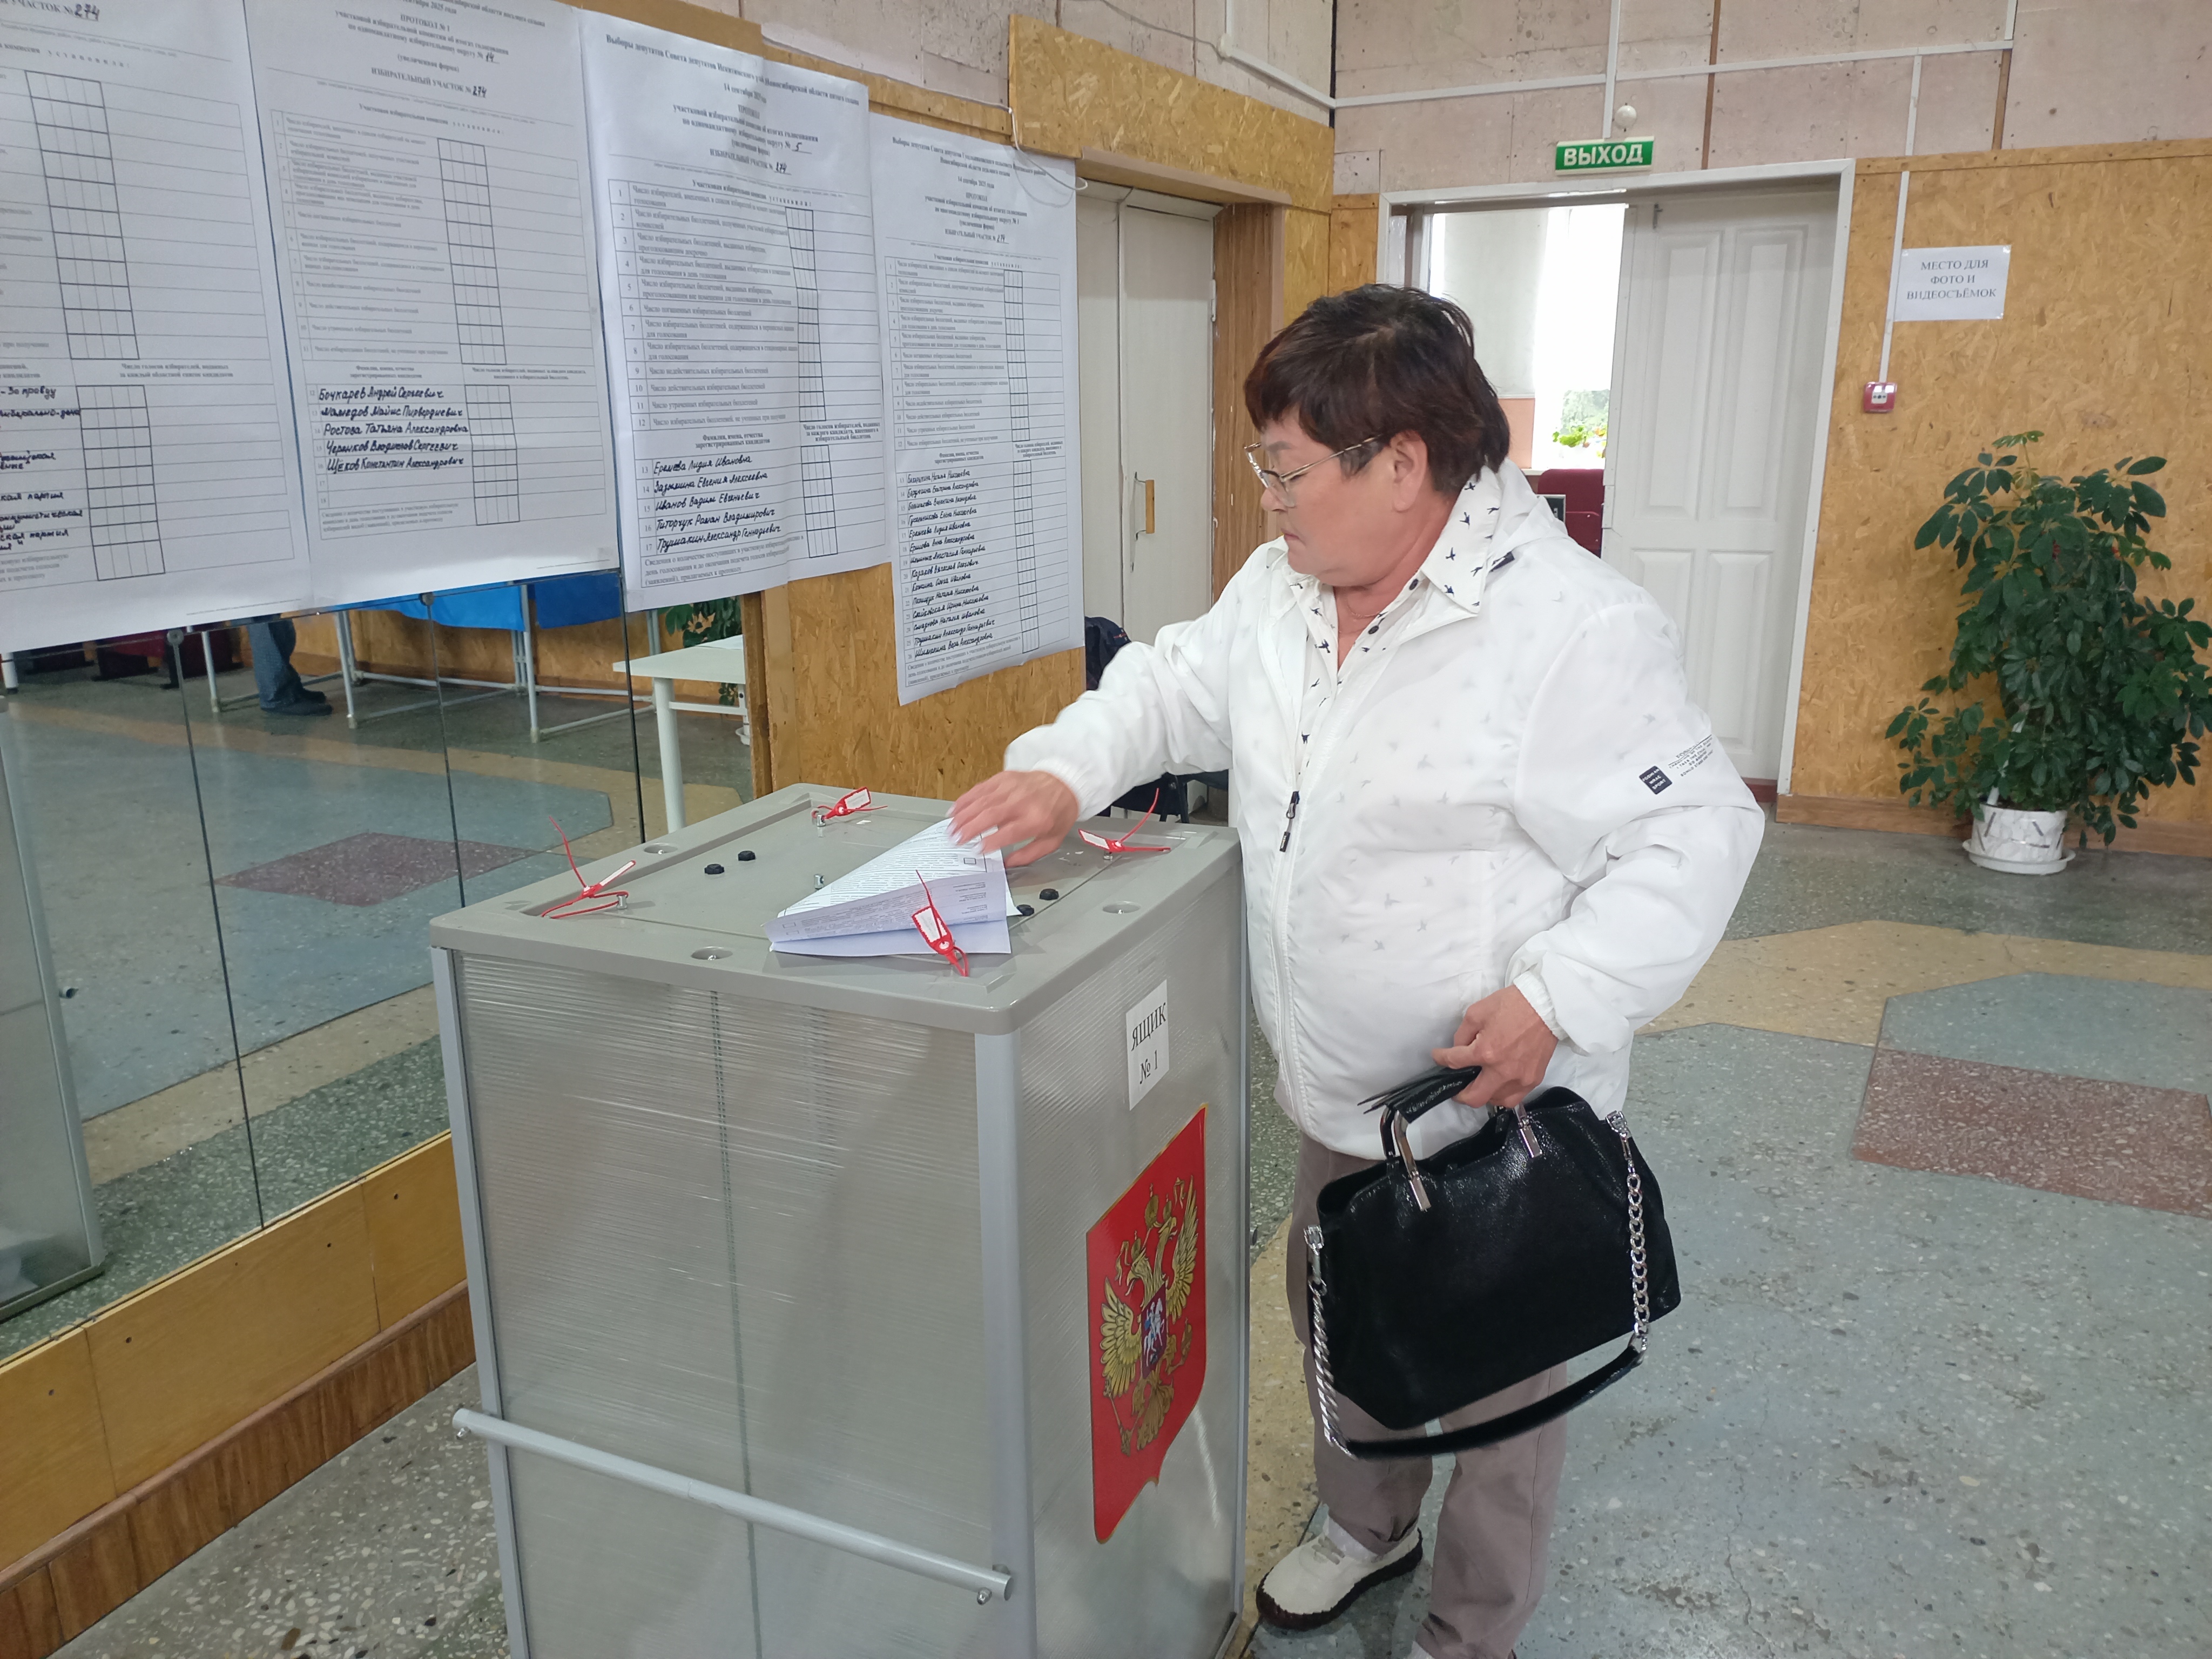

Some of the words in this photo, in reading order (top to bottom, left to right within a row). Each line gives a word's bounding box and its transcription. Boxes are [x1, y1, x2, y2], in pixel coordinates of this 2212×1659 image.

[1563, 144, 1643, 166] ВЫХОД
[1921, 261, 1961, 271] МЕСТО
[1965, 260, 1988, 269] ДЛЯ
[1931, 275, 1964, 285] ФОТО
[1967, 275, 1975, 283] И
[1907, 288, 1996, 300] ВИДЕОСЪЁМОК
[319, 387, 366, 404] Бочкарев
[368, 386, 396, 401] Андрей
[399, 387, 444, 399] Сергеевич
[323, 423, 363, 435] Ростова
[366, 423, 403, 434] Татьяна
[406, 422, 469, 435] Александровна
[414, 439, 459, 452] Сергеевич
[361, 457, 404, 469] Константин
[406, 456, 464, 470] Александрович
[642, 465, 649, 474] 13
[689, 461, 713, 473] Лидия
[715, 455, 752, 467] Ивановна
[697, 477, 728, 488] Евгения
[729, 471, 768, 483] Алексеевна
[643, 485, 650, 494] 14
[656, 497, 686, 511] Иванов
[689, 496, 716, 508] Вадим
[719, 491, 760, 503] Евгеньевич
[695, 514, 720, 525] Роман
[723, 508, 775, 524] Владимирович
[657, 538, 703, 553] Трушакин
[704, 530, 740, 542] Александр
[741, 523, 781, 537] Геннадьевич
[1131, 1002, 1166, 1051] ЯЩИК
[1140, 1059, 1151, 1084] №
[1154, 1050, 1158, 1070] 1
